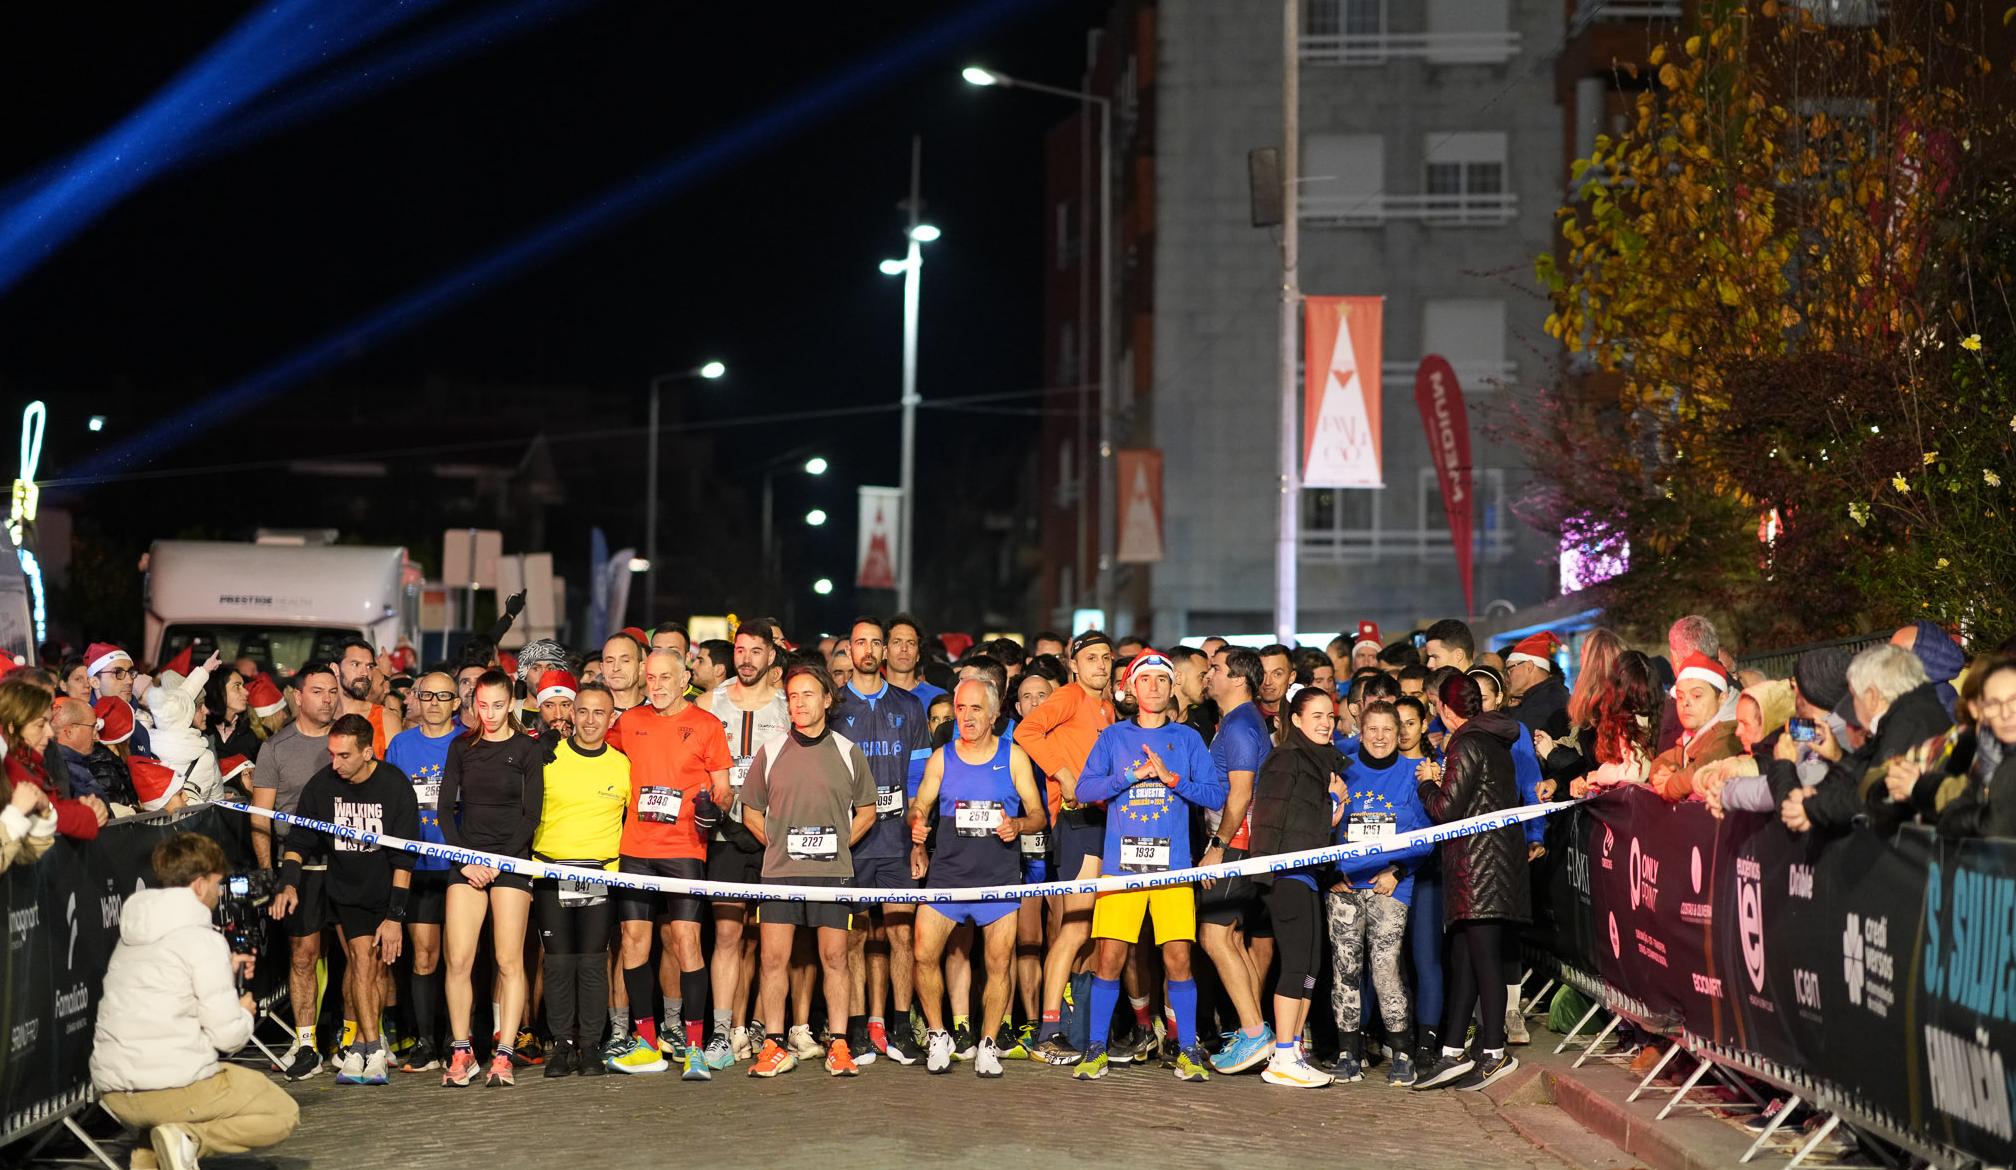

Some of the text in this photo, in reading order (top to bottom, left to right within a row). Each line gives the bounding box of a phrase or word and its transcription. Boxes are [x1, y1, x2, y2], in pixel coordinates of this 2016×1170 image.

[334, 802, 383, 818] WALKING
[801, 836, 823, 847] 2727
[1136, 847, 1155, 858] 1933
[1642, 854, 1659, 884] ONLY
[1924, 862, 1944, 998] S.
